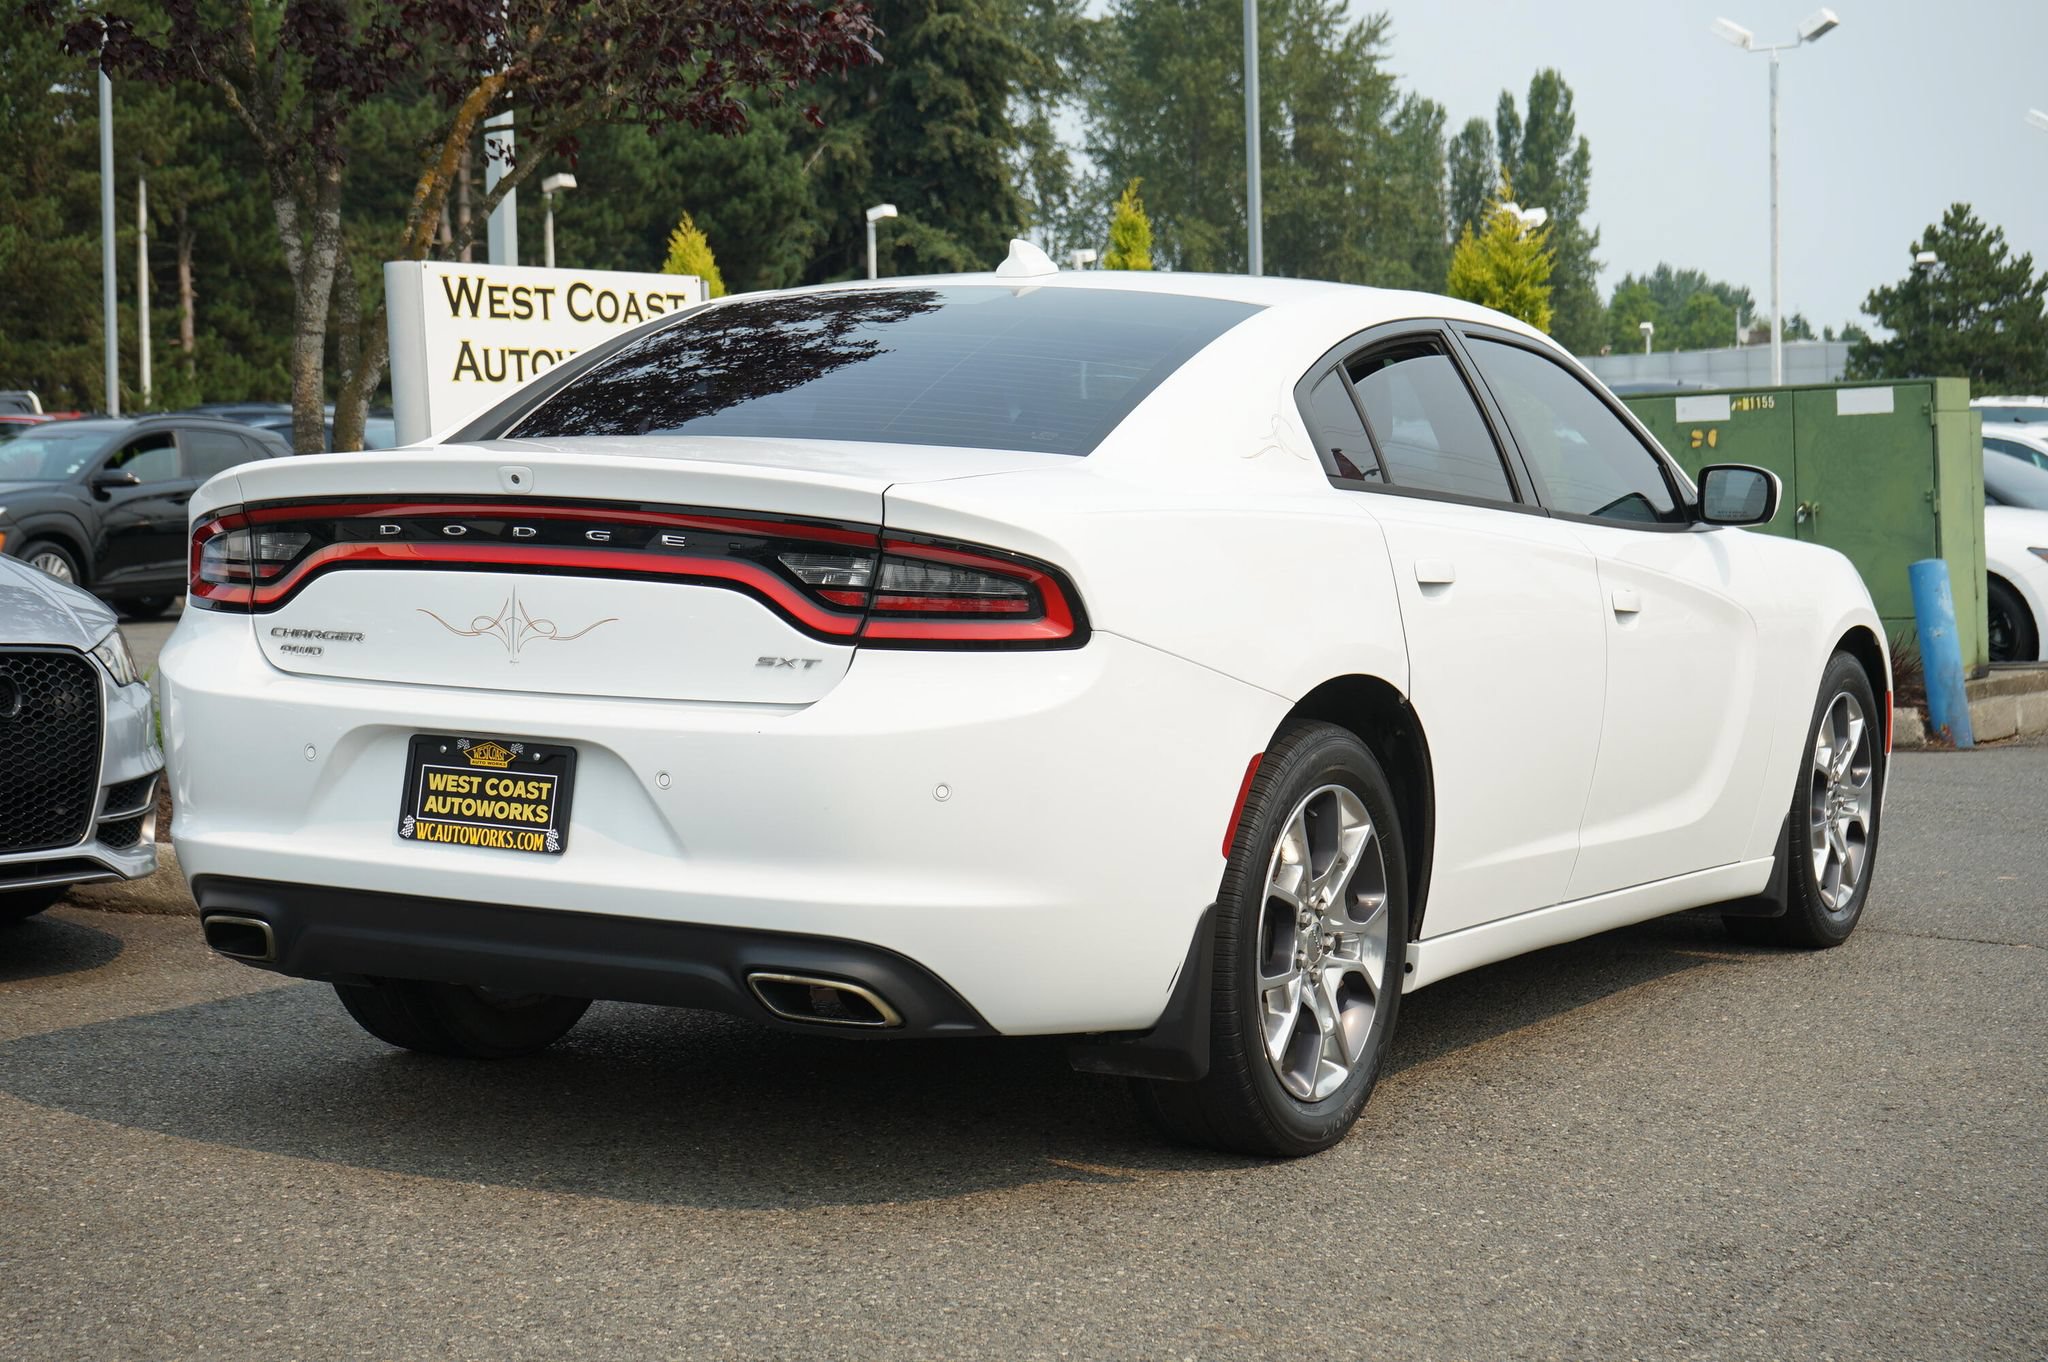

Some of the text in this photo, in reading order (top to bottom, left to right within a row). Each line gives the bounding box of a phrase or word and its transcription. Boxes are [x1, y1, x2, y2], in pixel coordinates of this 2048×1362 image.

[441, 275, 555, 321] WEST
[452, 340, 577, 383] AUTO
[379, 523, 687, 548] DODGE
[270, 627, 365, 641] CHARGER
[755, 656, 822, 669] SXT
[428, 773, 552, 800] WEST COAST
[424, 796, 549, 823] AUTOWORKS
[416, 822, 544, 851] WCAUTOWORKS.COM
